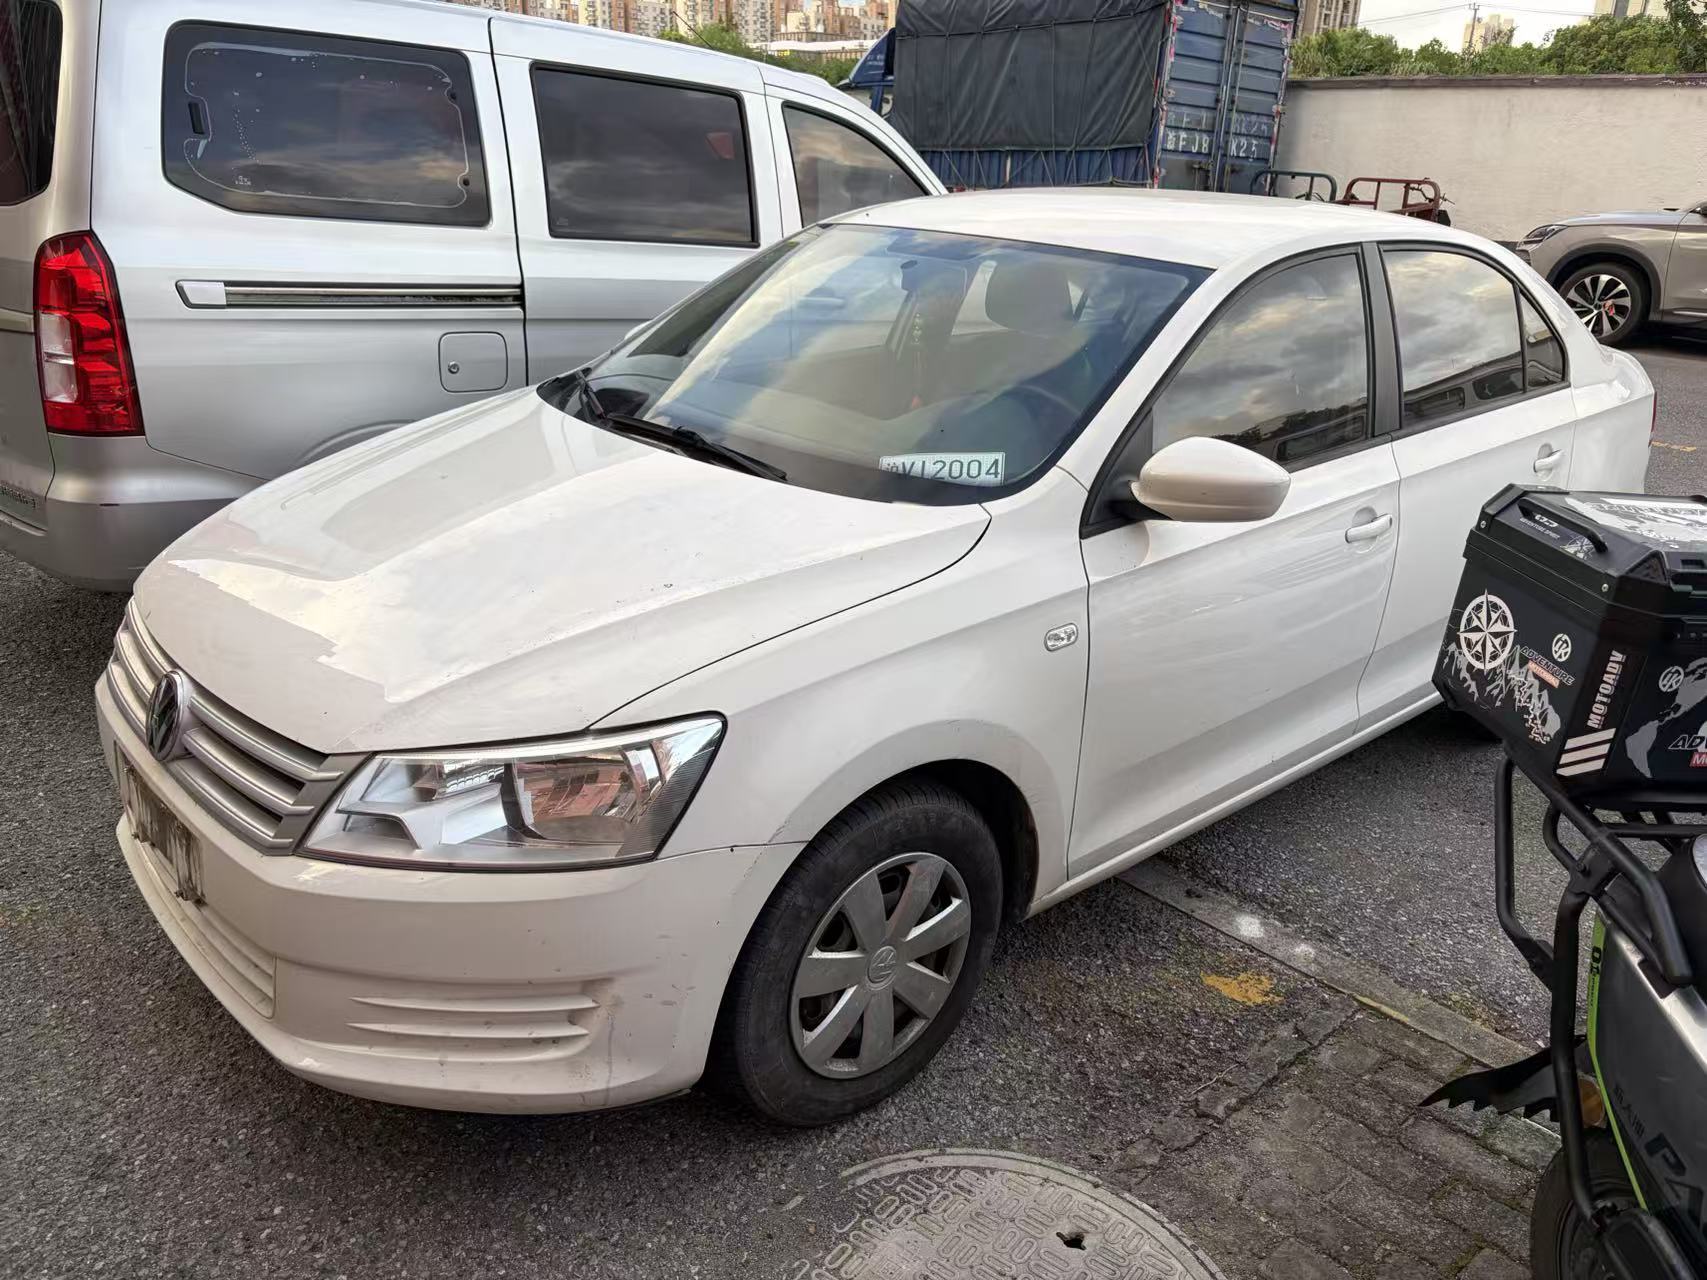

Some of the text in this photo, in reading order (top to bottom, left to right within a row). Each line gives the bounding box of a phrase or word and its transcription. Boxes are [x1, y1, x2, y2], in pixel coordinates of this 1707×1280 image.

[1520, 646, 1576, 686] ADVENTURE
[1586, 649, 1627, 730] MOTOADV
[1668, 734, 1707, 751] AD
